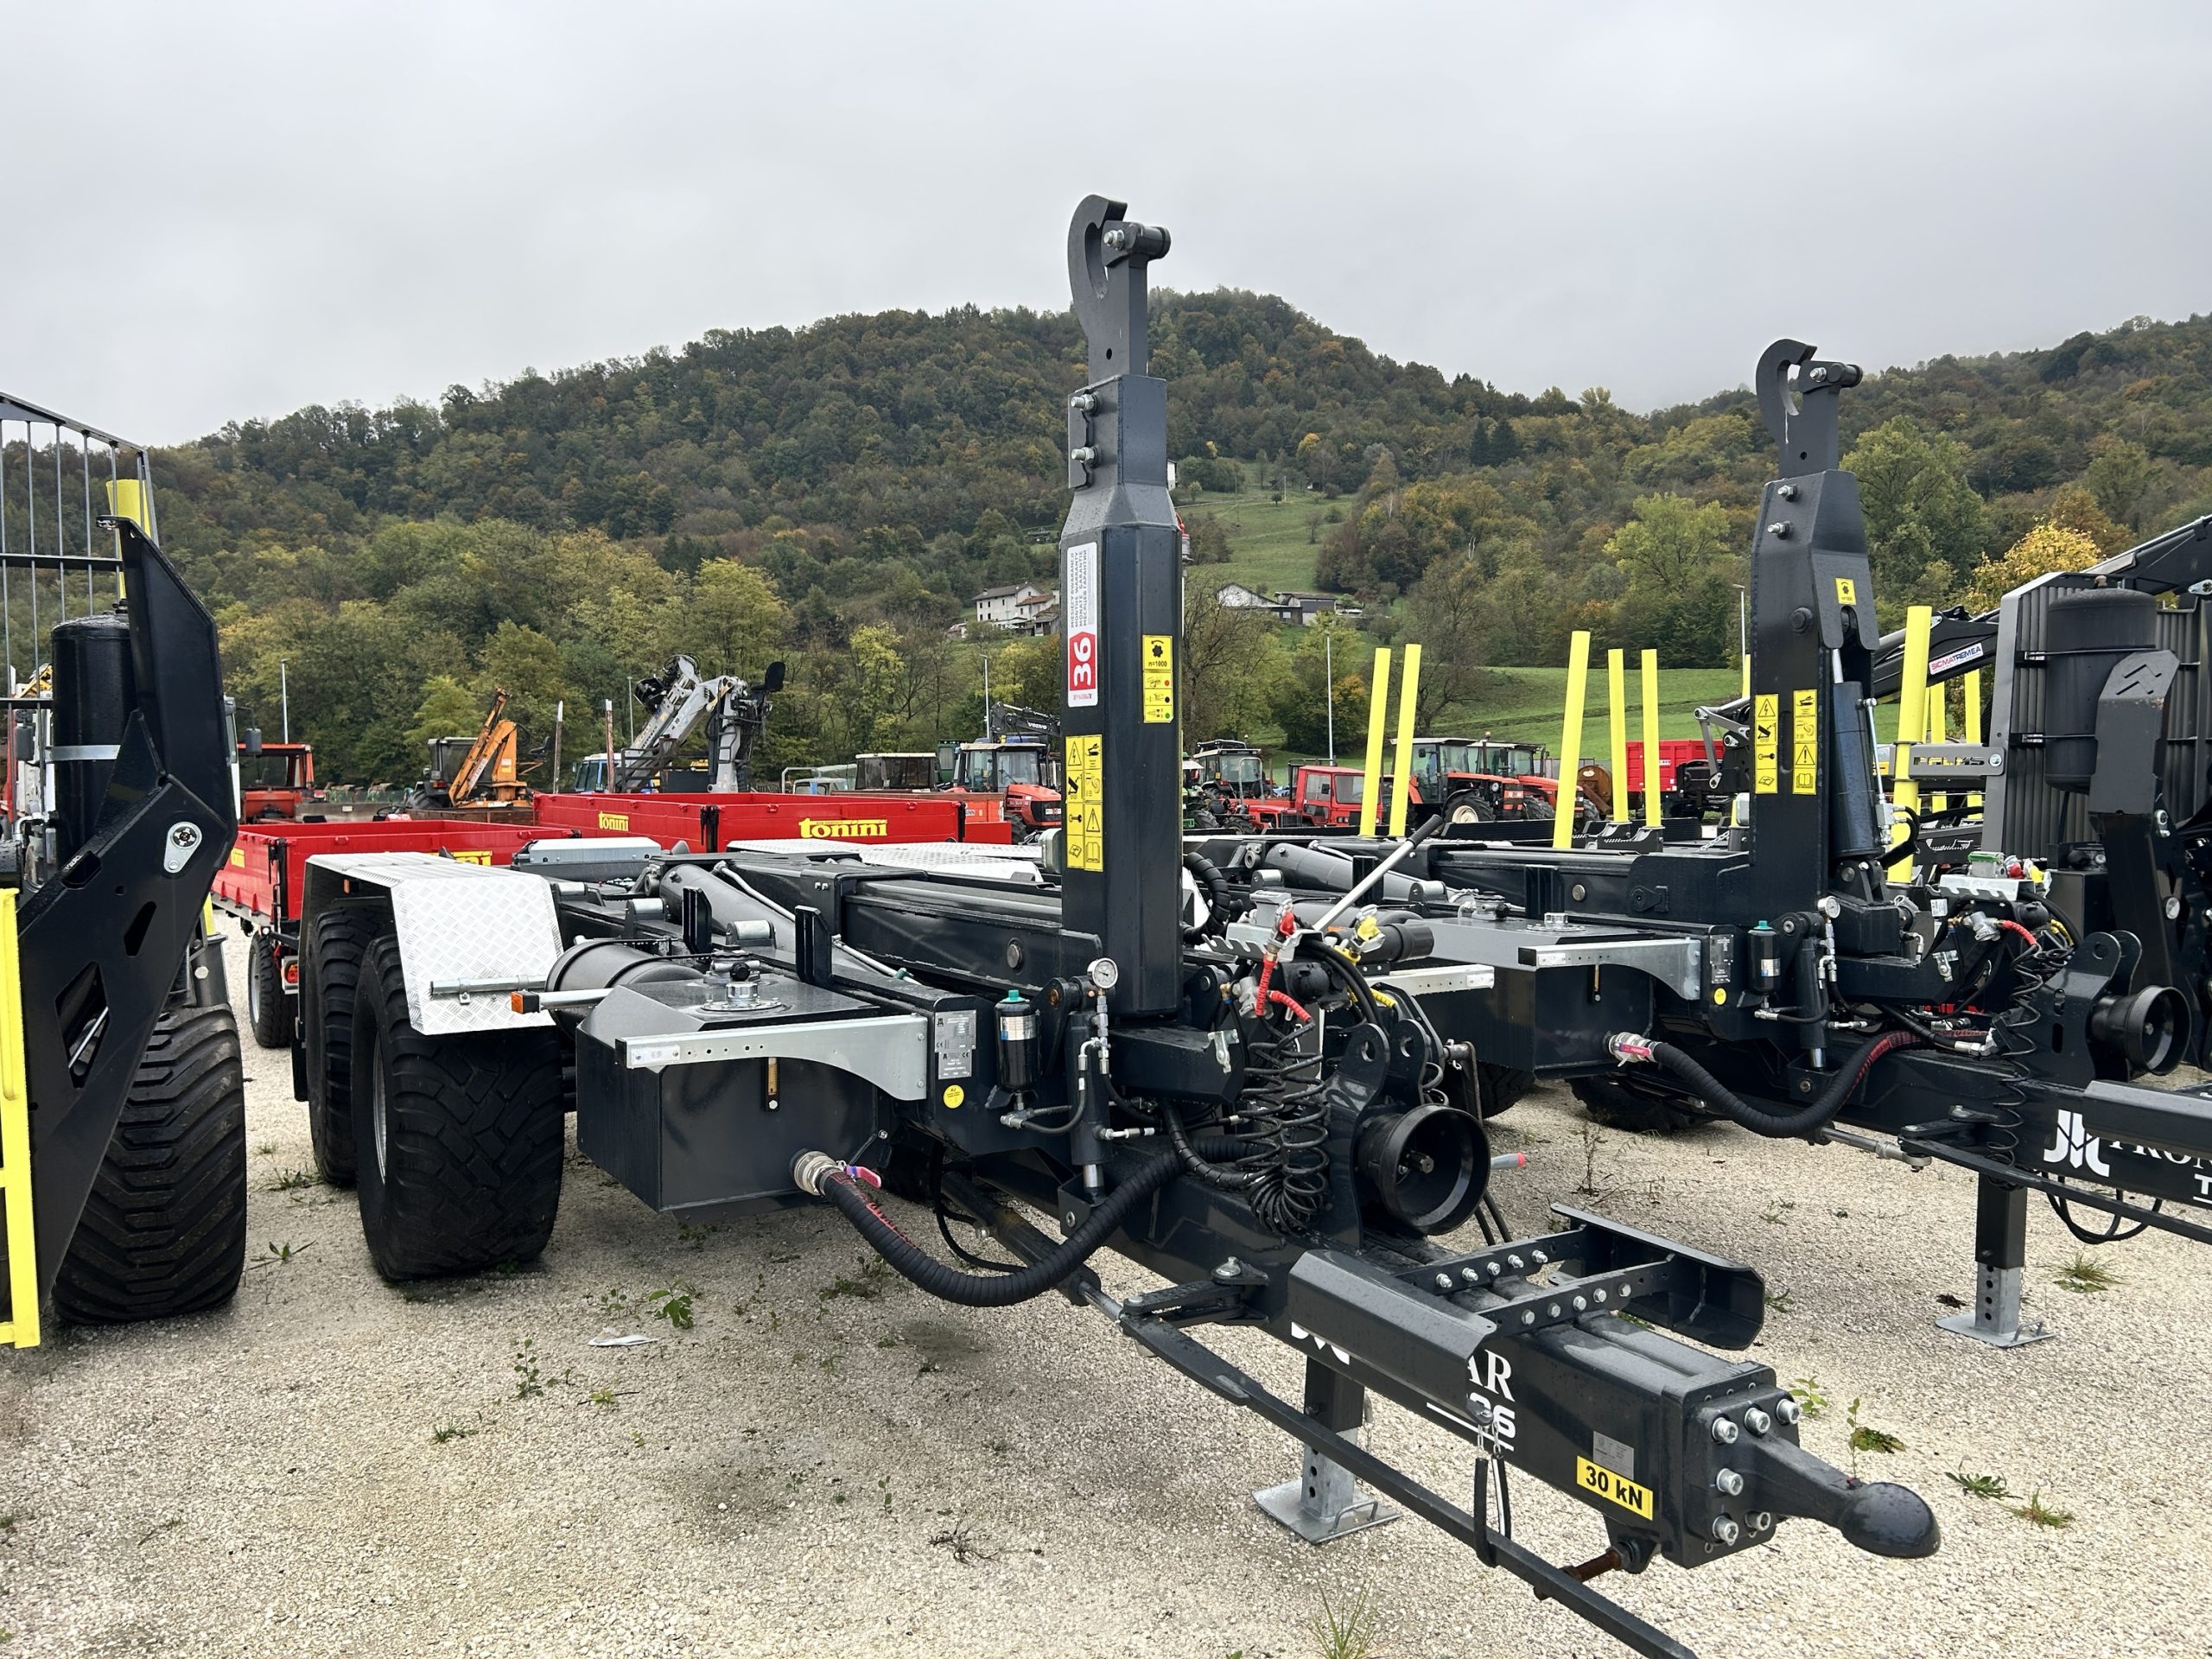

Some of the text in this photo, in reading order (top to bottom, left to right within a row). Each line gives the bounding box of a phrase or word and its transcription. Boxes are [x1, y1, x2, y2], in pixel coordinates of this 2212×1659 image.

[1073, 637, 1091, 687] 36
[598, 810, 629, 832] tonini
[798, 817, 888, 839] tonini
[1586, 1465, 1643, 1510] 30 kN
